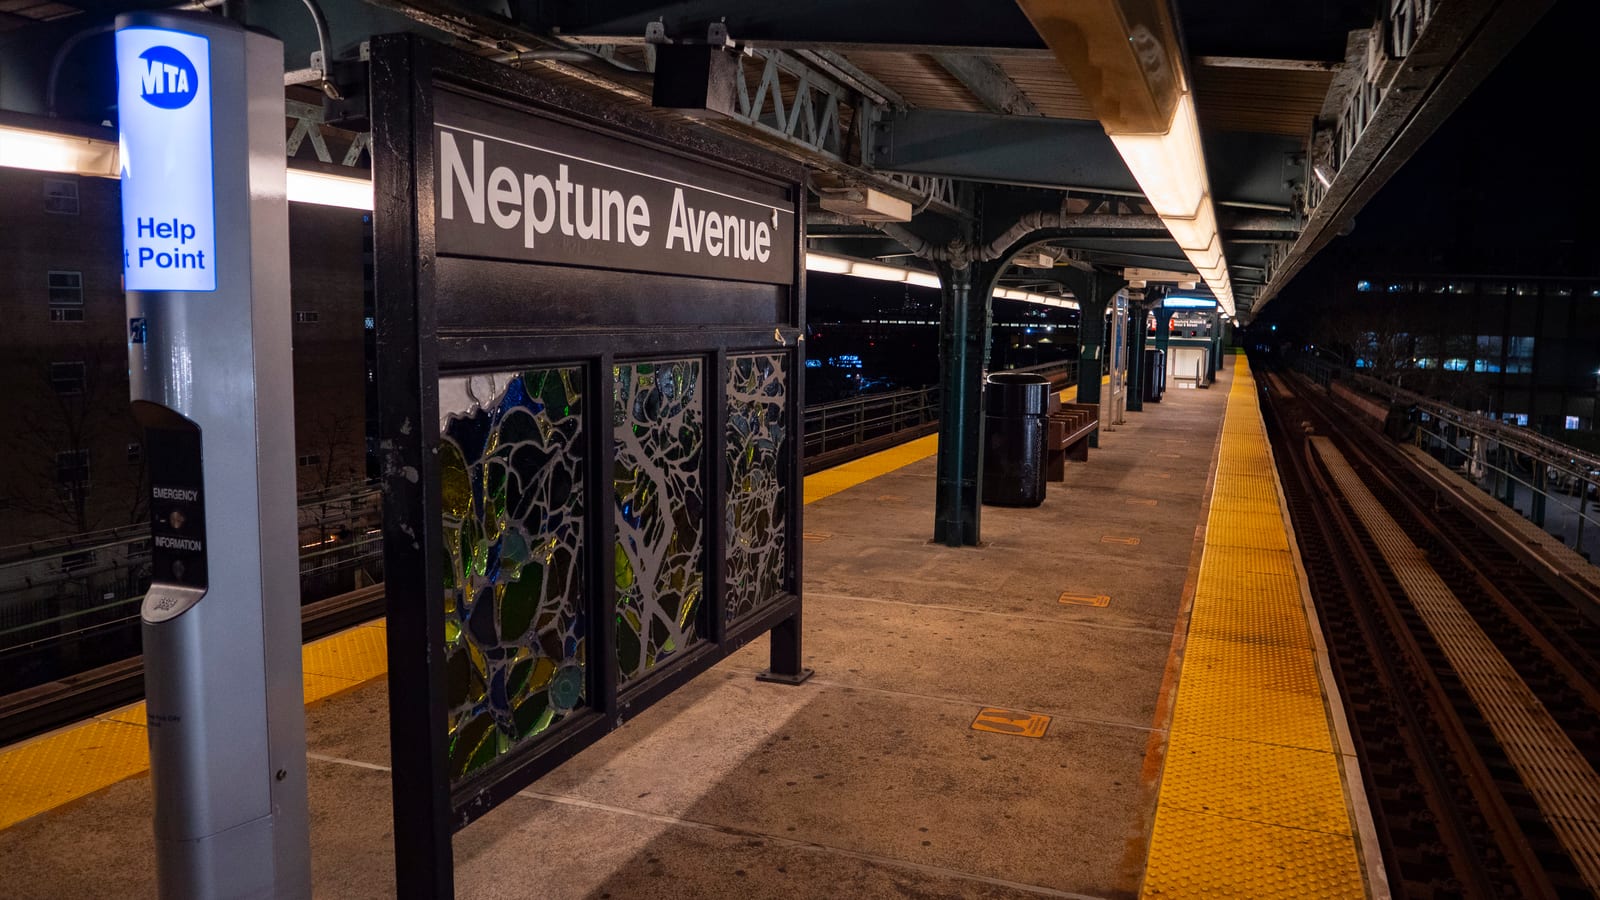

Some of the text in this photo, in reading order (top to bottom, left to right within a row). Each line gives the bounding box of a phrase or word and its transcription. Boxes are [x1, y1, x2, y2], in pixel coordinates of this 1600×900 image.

[139, 57, 189, 95] MTA
[440, 131, 771, 264] Neptune Avenue
[137, 217, 196, 245] Help
[138, 247, 206, 270] Point
[153, 487, 198, 501] EMERGENCY
[155, 536, 202, 551] INFORMATION
